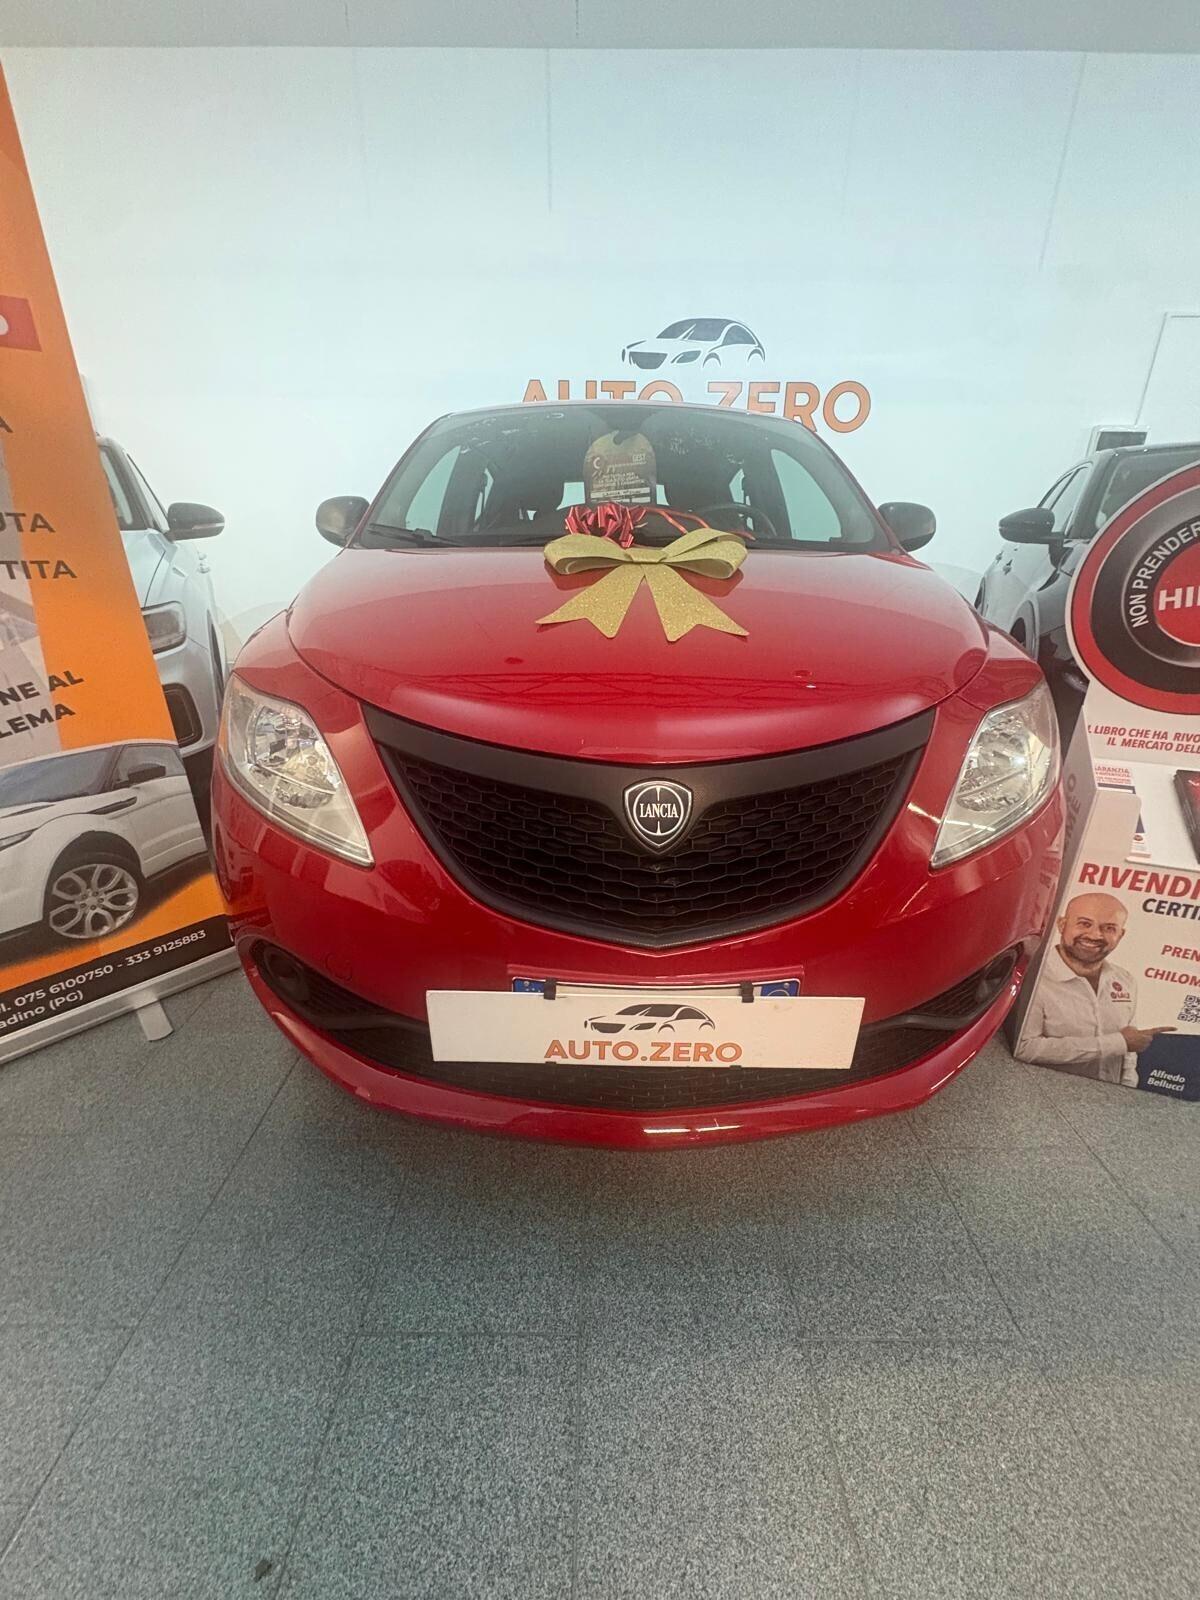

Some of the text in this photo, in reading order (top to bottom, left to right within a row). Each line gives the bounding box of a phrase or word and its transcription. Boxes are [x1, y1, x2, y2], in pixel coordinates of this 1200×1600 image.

[1158, 586, 1200, 611] HI
[1129, 594, 1149, 628] NON
[48, 670, 84, 692] AL
[1094, 725, 1127, 737] LIBRO
[1128, 728, 1151, 739] CHE
[1152, 730, 1169, 741] HA
[1106, 737, 1117, 746] IL
[1120, 738, 1174, 752] MERCATO
[639, 803, 679, 818] LANCIA
[1142, 898, 1200, 921] CERTI
[14, 988, 46, 1008] 075
[49, 964, 114, 994] 6100750
[124, 950, 151, 967] 333
[153, 929, 207, 956] 9125883
[49, 989, 84, 1011] (PG)
[544, 1039, 743, 1063] AUTO.ZERO
[1147, 1076, 1185, 1092] Bellucci
[1150, 1069, 1186, 1083] Alfredo
